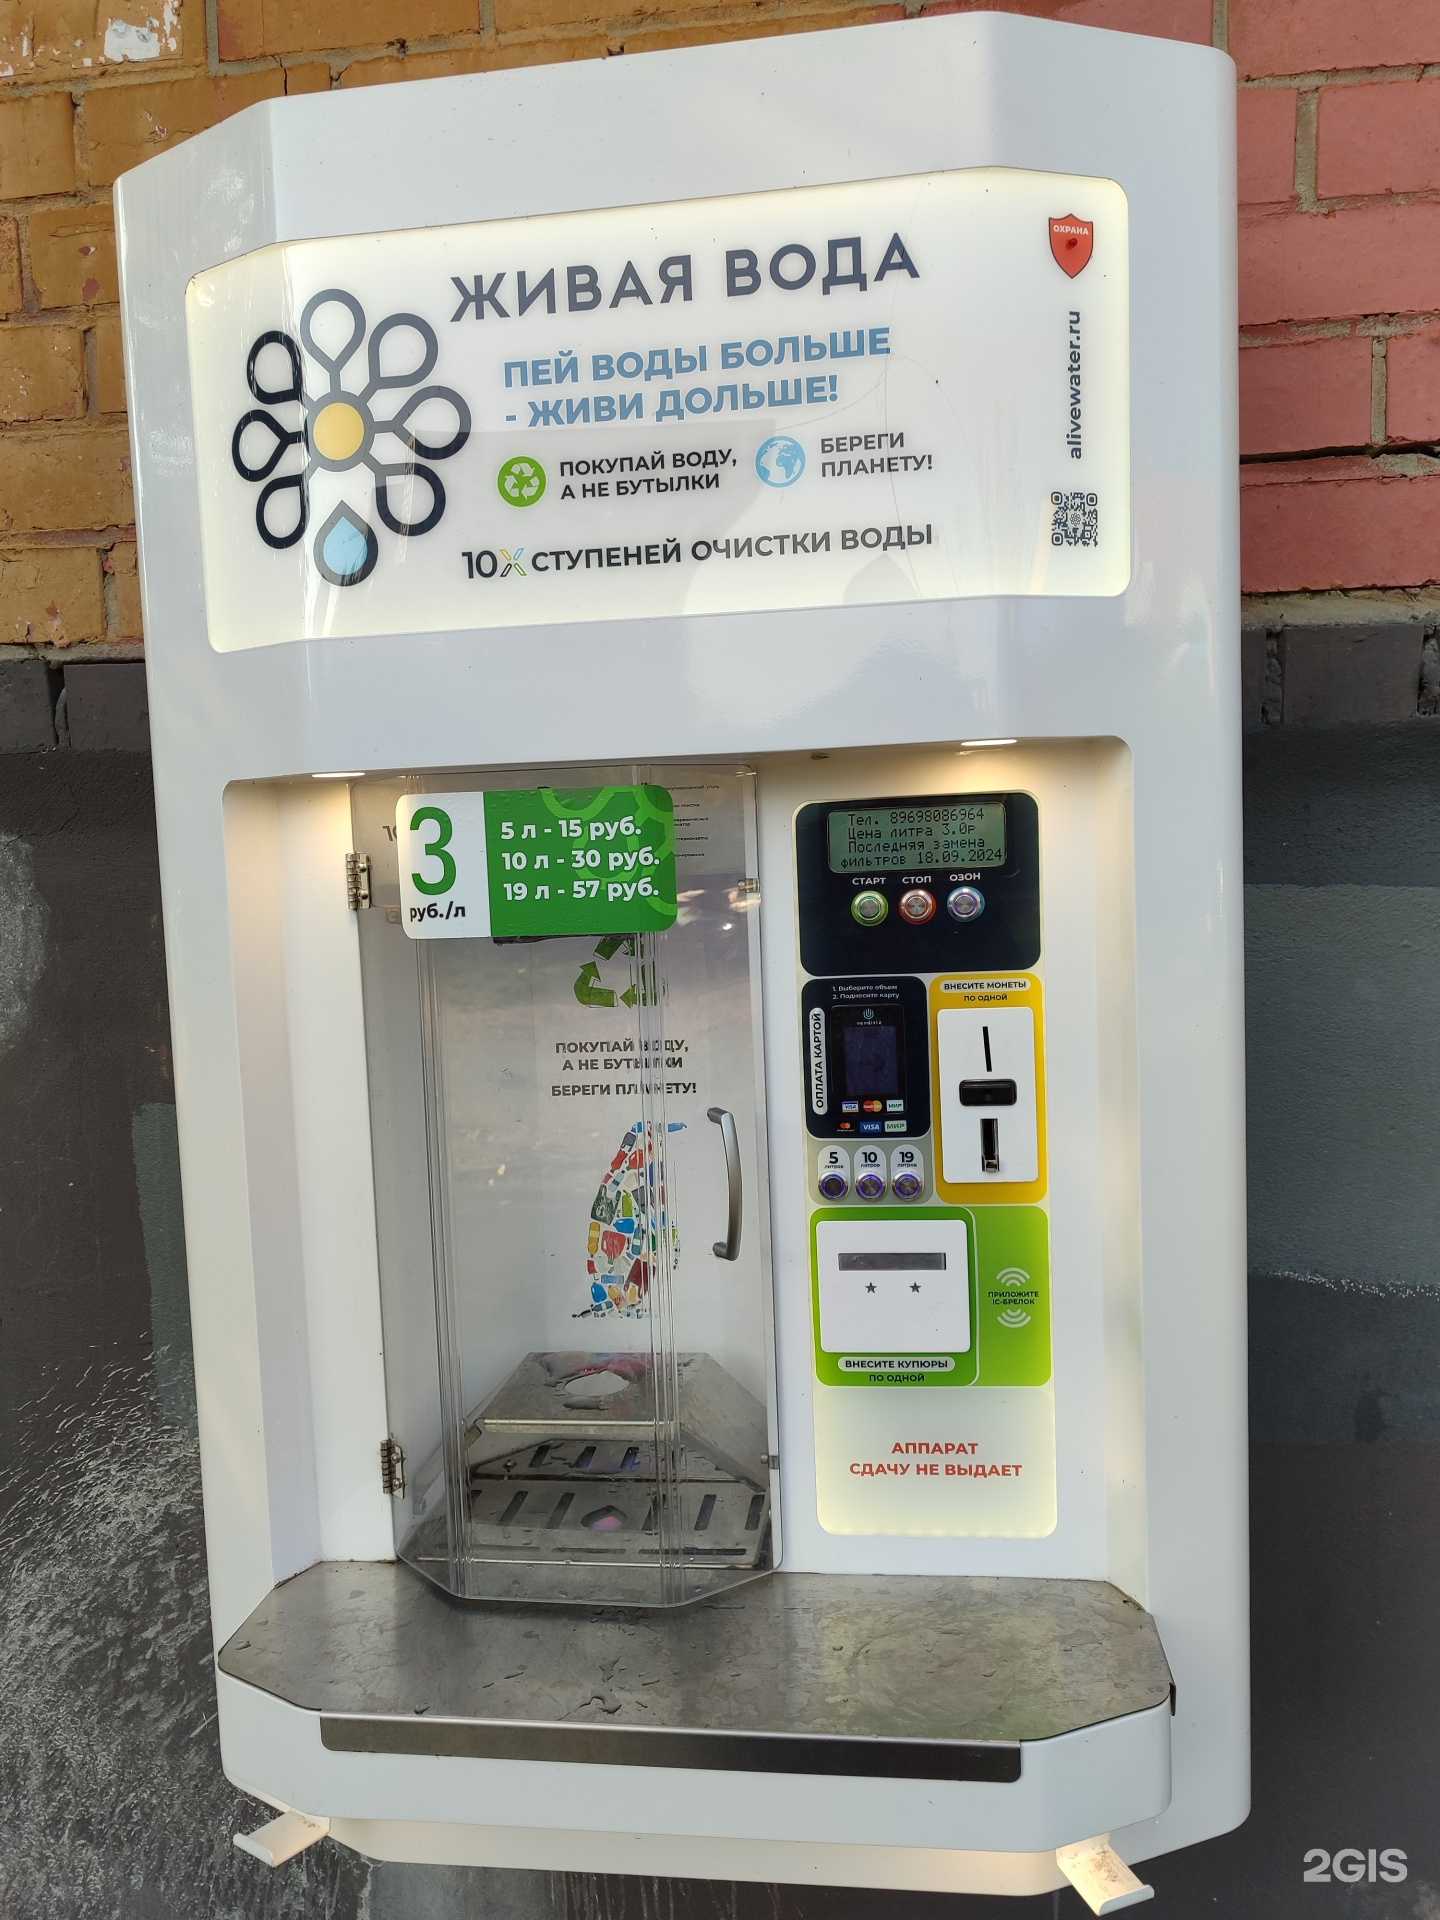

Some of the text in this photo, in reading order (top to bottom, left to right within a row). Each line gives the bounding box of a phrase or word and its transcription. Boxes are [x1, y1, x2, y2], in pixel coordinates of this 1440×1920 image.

[1053, 224, 1089, 235] ОХРАНА
[450, 232, 920, 322] ЖИВАЯ ВОДА
[504, 326, 891, 389] ПЕЙ ВОДЫ БОЛЬШЕ
[1066, 310, 1082, 459] alivewater.ru
[528, 393, 644, 428] ЖИВИ
[655, 373, 839, 422] ДОЛЬШЕ!
[820, 432, 906, 455] БЕРЕГИ
[559, 447, 738, 477] ПОКУПАЙ ВОДУ,
[821, 454, 933, 478] ПЛАНЕТУ!
[560, 473, 721, 500] А НЕ БУТЫЛКИ
[530, 538, 682, 573] СТУПЕНЕЙ
[691, 531, 832, 561] ОЧИСТКИ
[840, 524, 933, 554] ВОДЫ
[848, 808, 985, 827] Тел. 89698086964
[500, 822, 514, 840] 5
[521, 825, 537, 840] л
[559, 820, 583, 838] 15
[590, 816, 642, 841] руб.
[848, 826, 882, 841] Цена
[890, 826, 933, 839] литра
[410, 806, 457, 895] 3
[849, 836, 985, 855] Последняя замена
[501, 852, 527, 870] 10
[534, 855, 550, 870] л
[571, 850, 601, 868] 30
[608, 846, 660, 872] руб.
[840, 847, 1003, 870] фильтров 18.09.2024
[852, 876, 887, 886] СТАРТ
[902, 875, 932, 885] СТОП
[949, 872, 981, 882] ОЗОН
[503, 883, 528, 901] 19
[534, 885, 550, 901] л
[572, 880, 600, 899] 57
[607, 876, 660, 902] руб.
[409, 901, 466, 922] руб./л
[838, 984, 873, 992] Выберите
[944, 980, 1027, 991] ВНЕСИТЕ МОНЕТЫ
[840, 992, 878, 1000] Поднесите
[978, 992, 1008, 1003] ОДНОЙ
[555, 1038, 634, 1053] ПОКУПАЙ
[562, 1059, 574, 1071] А
[578, 1058, 599, 1070] НЕ
[812, 1012, 824, 1109] ОПЛАТА КАРТОЙ
[551, 1083, 611, 1096] БЕРЕГИ
[829, 1151, 839, 1164] 5
[862, 1151, 878, 1163] 10
[899, 1151, 914, 1163] 19
[845, 1360, 948, 1369] ВНЕСИТЕ КУПЮРЫ
[869, 1373, 925, 1384] ПО ОДНОЙ
[892, 1443, 978, 1455] АППАРАТ
[850, 1463, 1023, 1478] СДАЧУ НЕ ВЫДАЕТ
